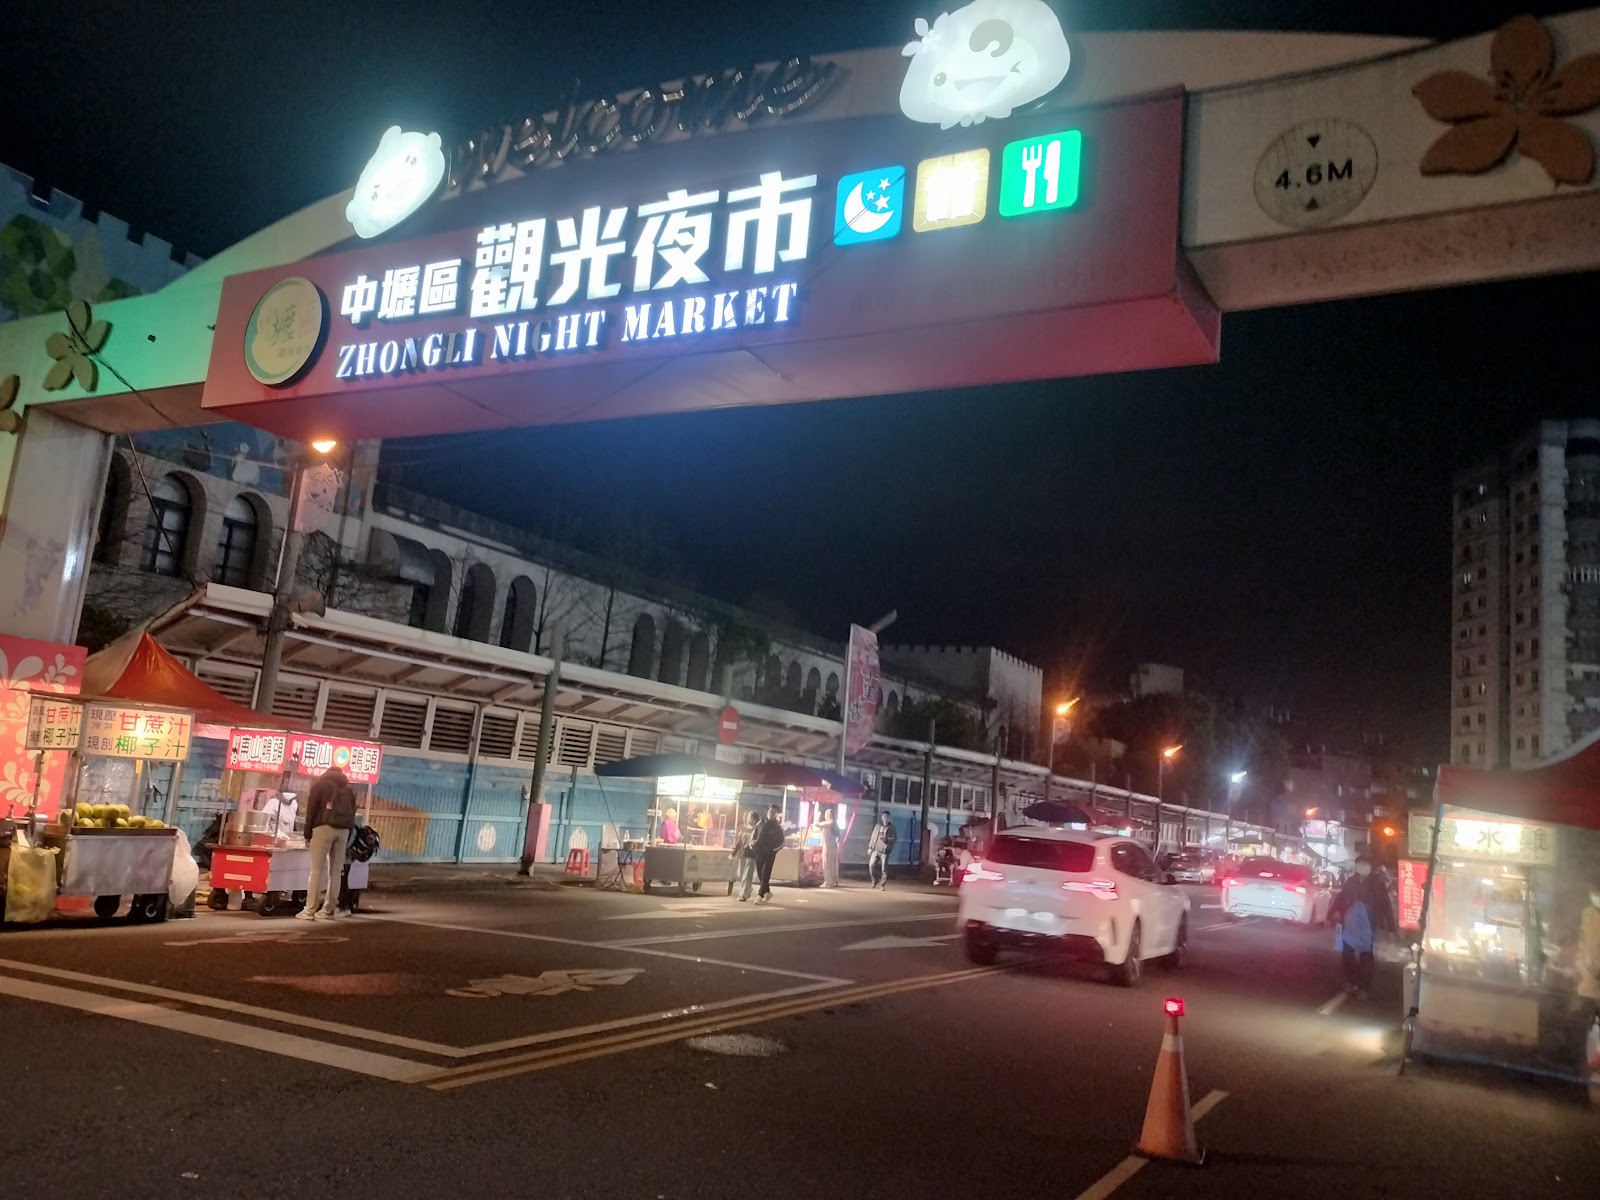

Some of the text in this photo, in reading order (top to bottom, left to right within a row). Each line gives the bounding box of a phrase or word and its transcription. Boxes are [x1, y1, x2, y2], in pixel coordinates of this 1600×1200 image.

[1274, 157, 1353, 190] 4.6M
[340, 170, 818, 324] 中壢區 觀光夜市
[335, 282, 798, 379] ZHONGLI NIGHT MARKET
[46, 705, 82, 724] 甘蔗汁
[119, 711, 188, 736] 甘蔗汁
[43, 727, 79, 746] 椰子汁
[115, 735, 185, 757] 椰子汁
[239, 734, 286, 764] 東山鴨頭
[301, 740, 333, 768] 東山
[350, 746, 380, 775] 鴨頭
